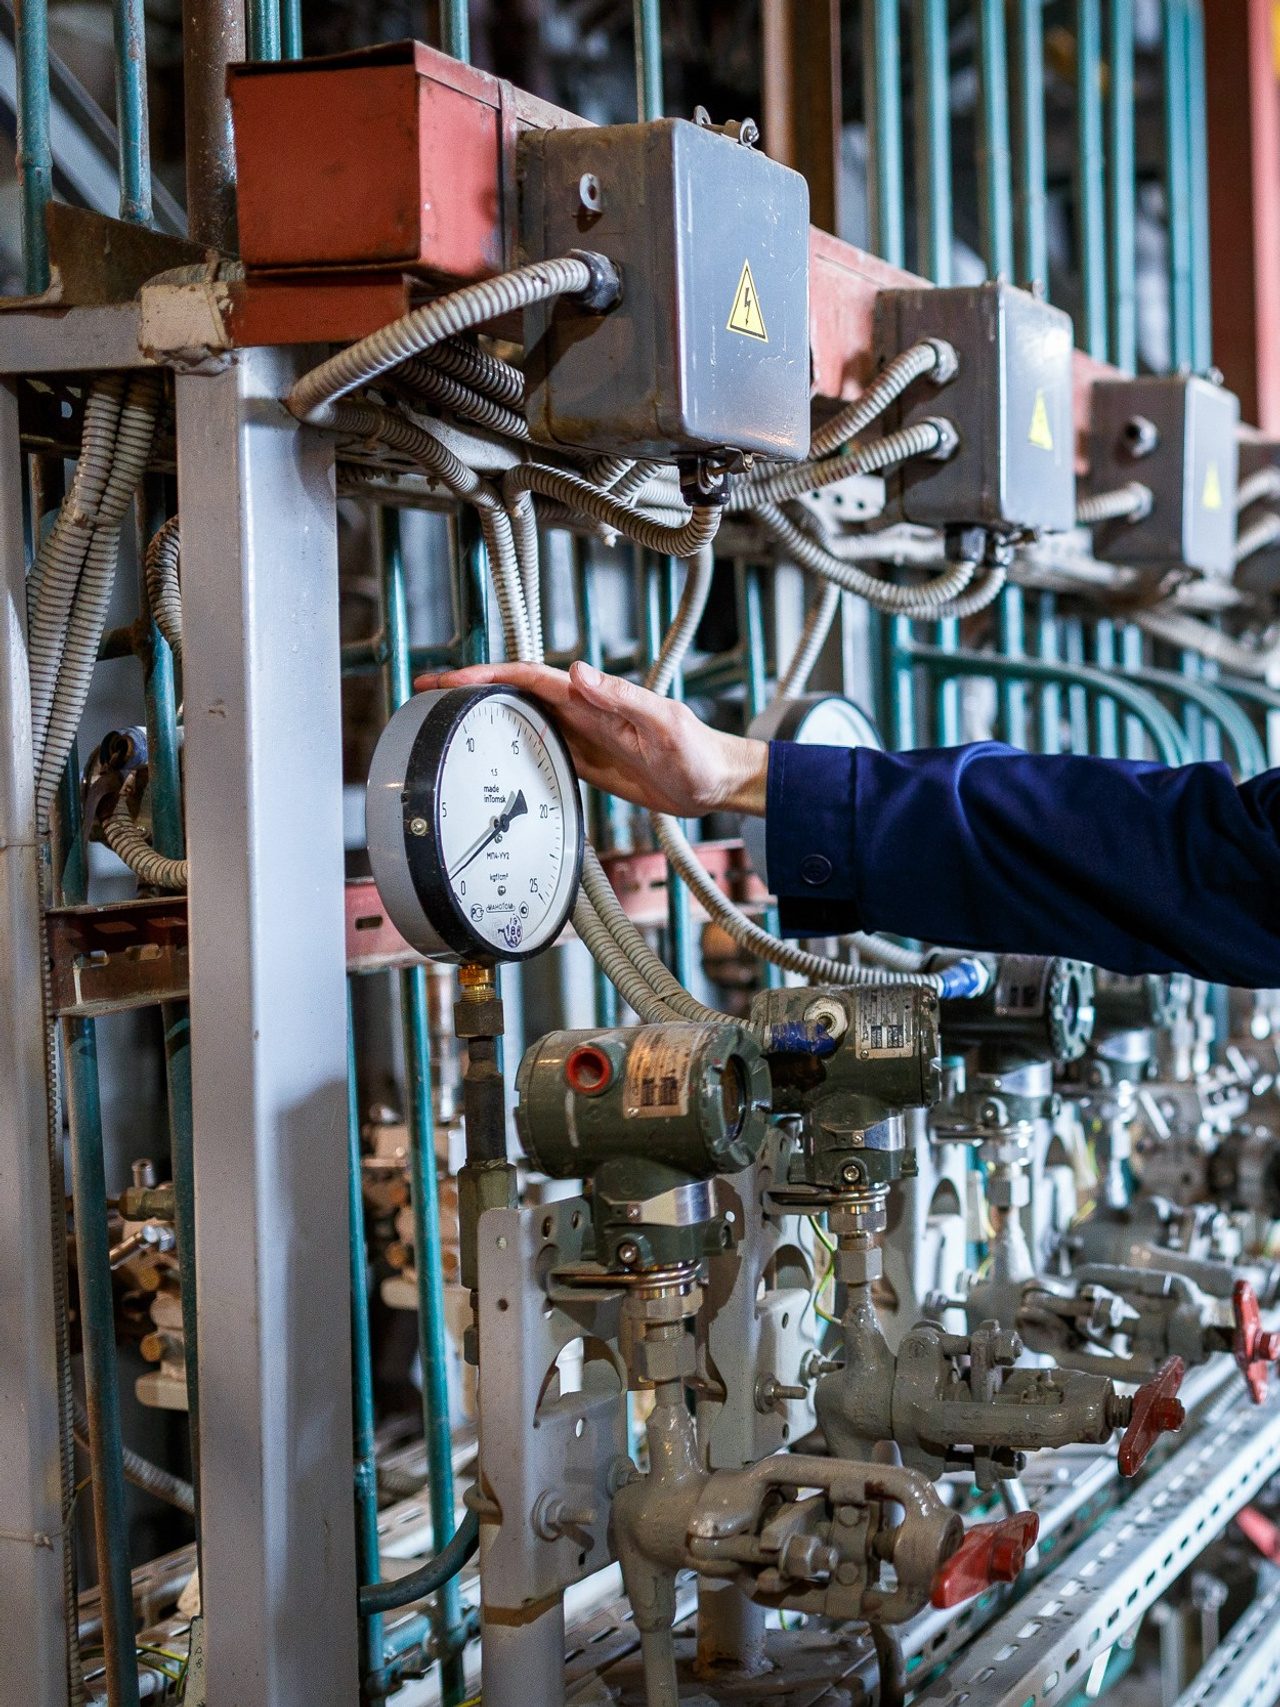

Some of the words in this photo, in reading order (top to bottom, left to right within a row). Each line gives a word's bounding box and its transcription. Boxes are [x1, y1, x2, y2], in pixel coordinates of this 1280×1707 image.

[466, 737, 475, 752] 10
[511, 740, 520, 755] 15
[483, 784, 499, 793] made
[442, 802, 447, 818] 5
[540, 804, 548, 819] 20
[460, 880, 466, 896] 0
[529, 877, 538, 893] 25
